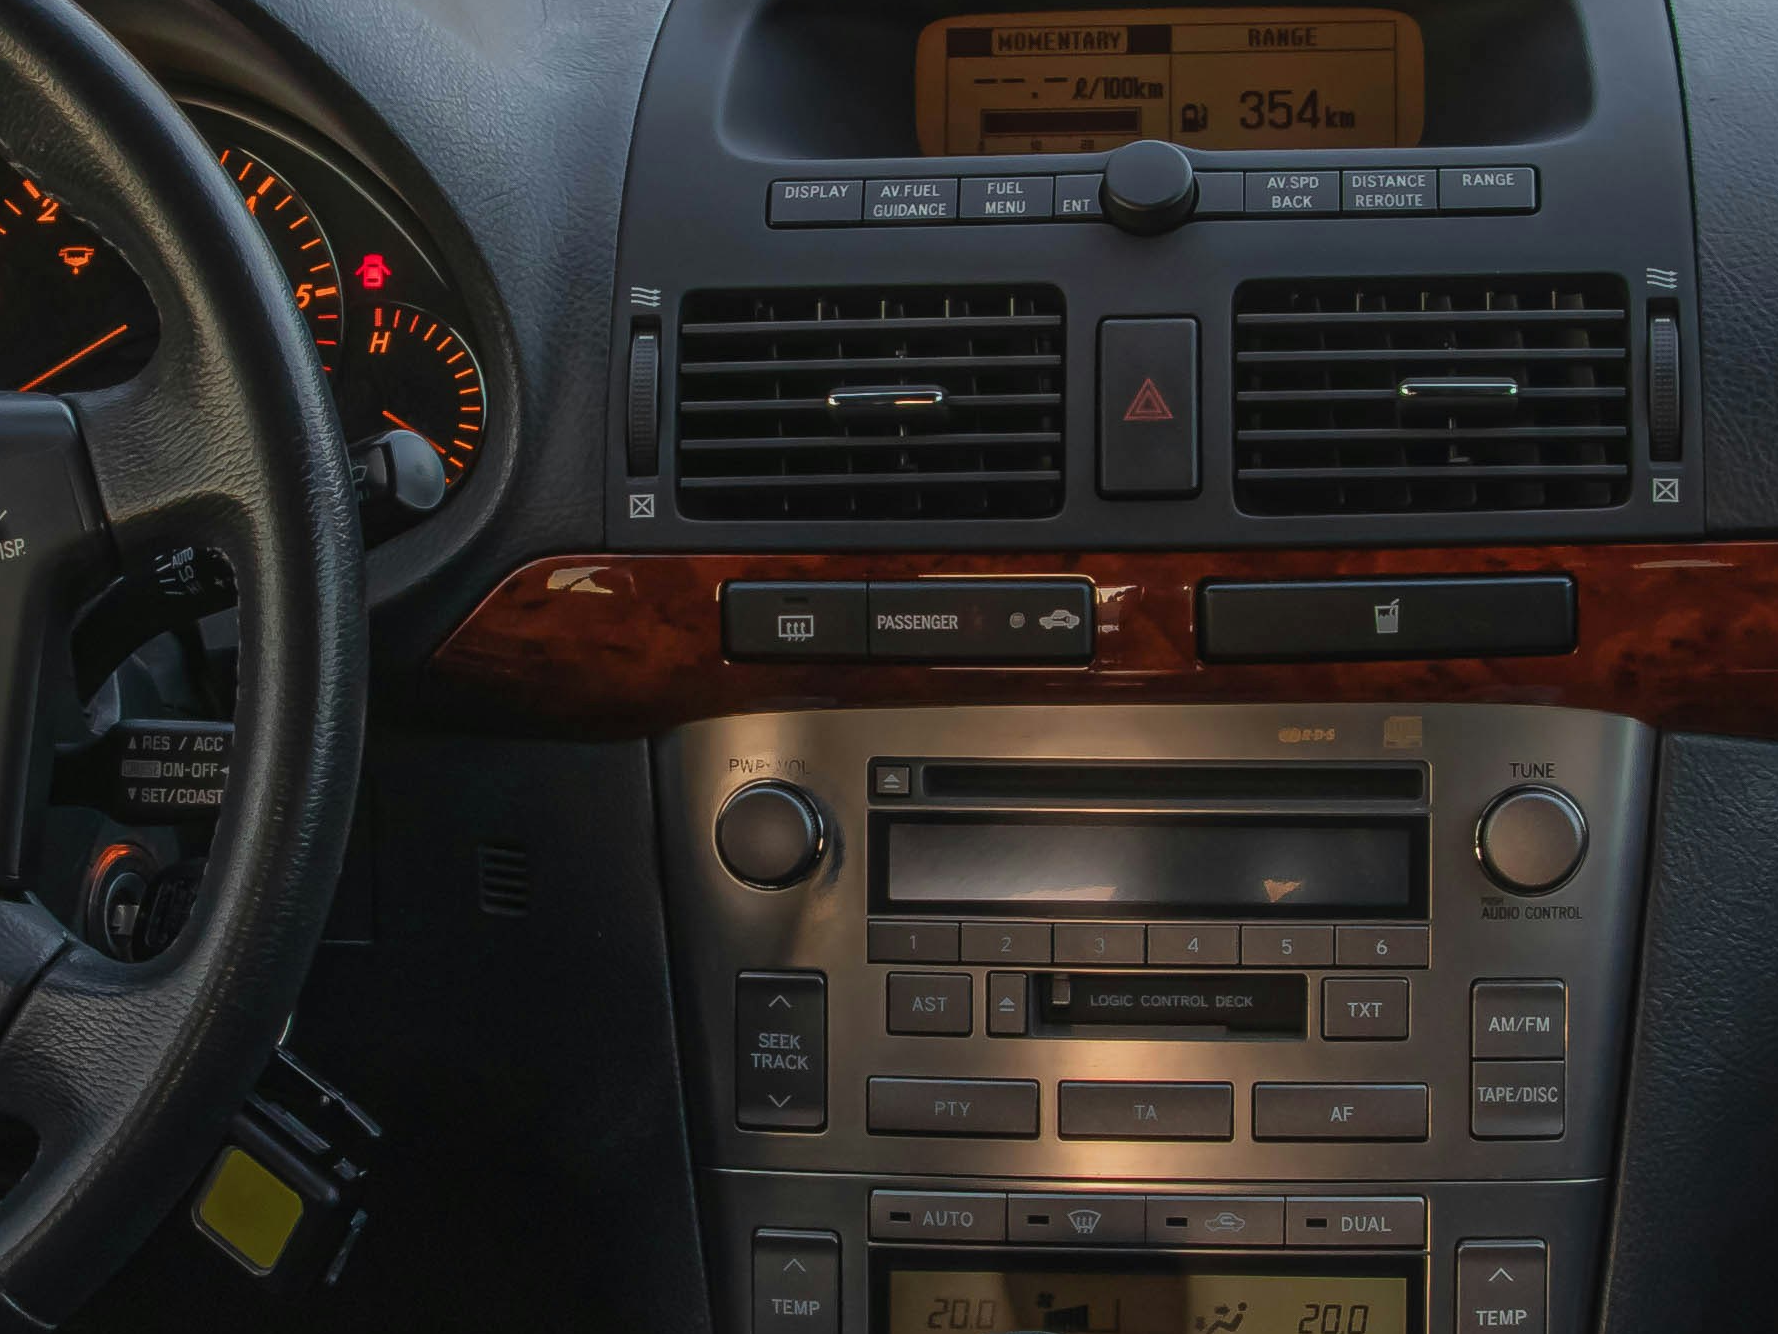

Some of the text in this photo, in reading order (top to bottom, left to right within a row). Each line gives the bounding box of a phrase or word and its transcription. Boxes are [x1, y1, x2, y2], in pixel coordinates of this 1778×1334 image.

[997, 31, 1122, 51] MOMENTARY
[1248, 27, 1318, 48] RANGE
[1239, 88, 1356, 131] 354 km
[1266, 176, 1319, 190] AV.SPD
[1352, 174, 1425, 187] DISTANCE
[1462, 173, 1514, 186] RANGE
[785, 185, 848, 198] DISPLAY
[987, 182, 1024, 194] FUEL
[985, 200, 1026, 214] MENU
[1063, 199, 1091, 212] ENT
[1272, 195, 1312, 208] BACK
[1355, 193, 1423, 207] REROUTE
[873, 203, 946, 217] GUIDANCE
[369, 331, 391, 354] H
[877, 614, 958, 630] PASSENGER
[142, 735, 170, 750] RES
[194, 736, 224, 752] ACC
[163, 762, 219, 778] ON-OFF
[1510, 763, 1556, 779] TUNE
[141, 788, 224, 804] SET/COAST
[1481, 906, 1582, 919] AUDIO CONTROL
[910, 935, 916, 949] 1
[1001, 937, 1012, 952] 2
[1094, 938, 1104, 954] 3
[1187, 937, 1198, 953] 4
[1282, 939, 1292, 955] 5
[1376, 939, 1388, 955] 6
[912, 997, 948, 1012] AST
[1090, 995, 1253, 1008] LOGIC CONTROL DECK
[1347, 1002, 1382, 1018] TXT
[1489, 1017, 1550, 1033] AM/FM
[758, 1033, 801, 1050] SEEK
[751, 1053, 809, 1070] TRACK
[1477, 1087, 1558, 1103] TAPE/DISC
[934, 1101, 971, 1116] PTY
[1134, 1105, 1158, 1120] TA
[1330, 1107, 1354, 1122] AF
[922, 1211, 973, 1227] AUTO
[1341, 1217, 1391, 1232] DUAL
[772, 1299, 820, 1315] TEMP
[1476, 1310, 1527, 1326] TEMP
